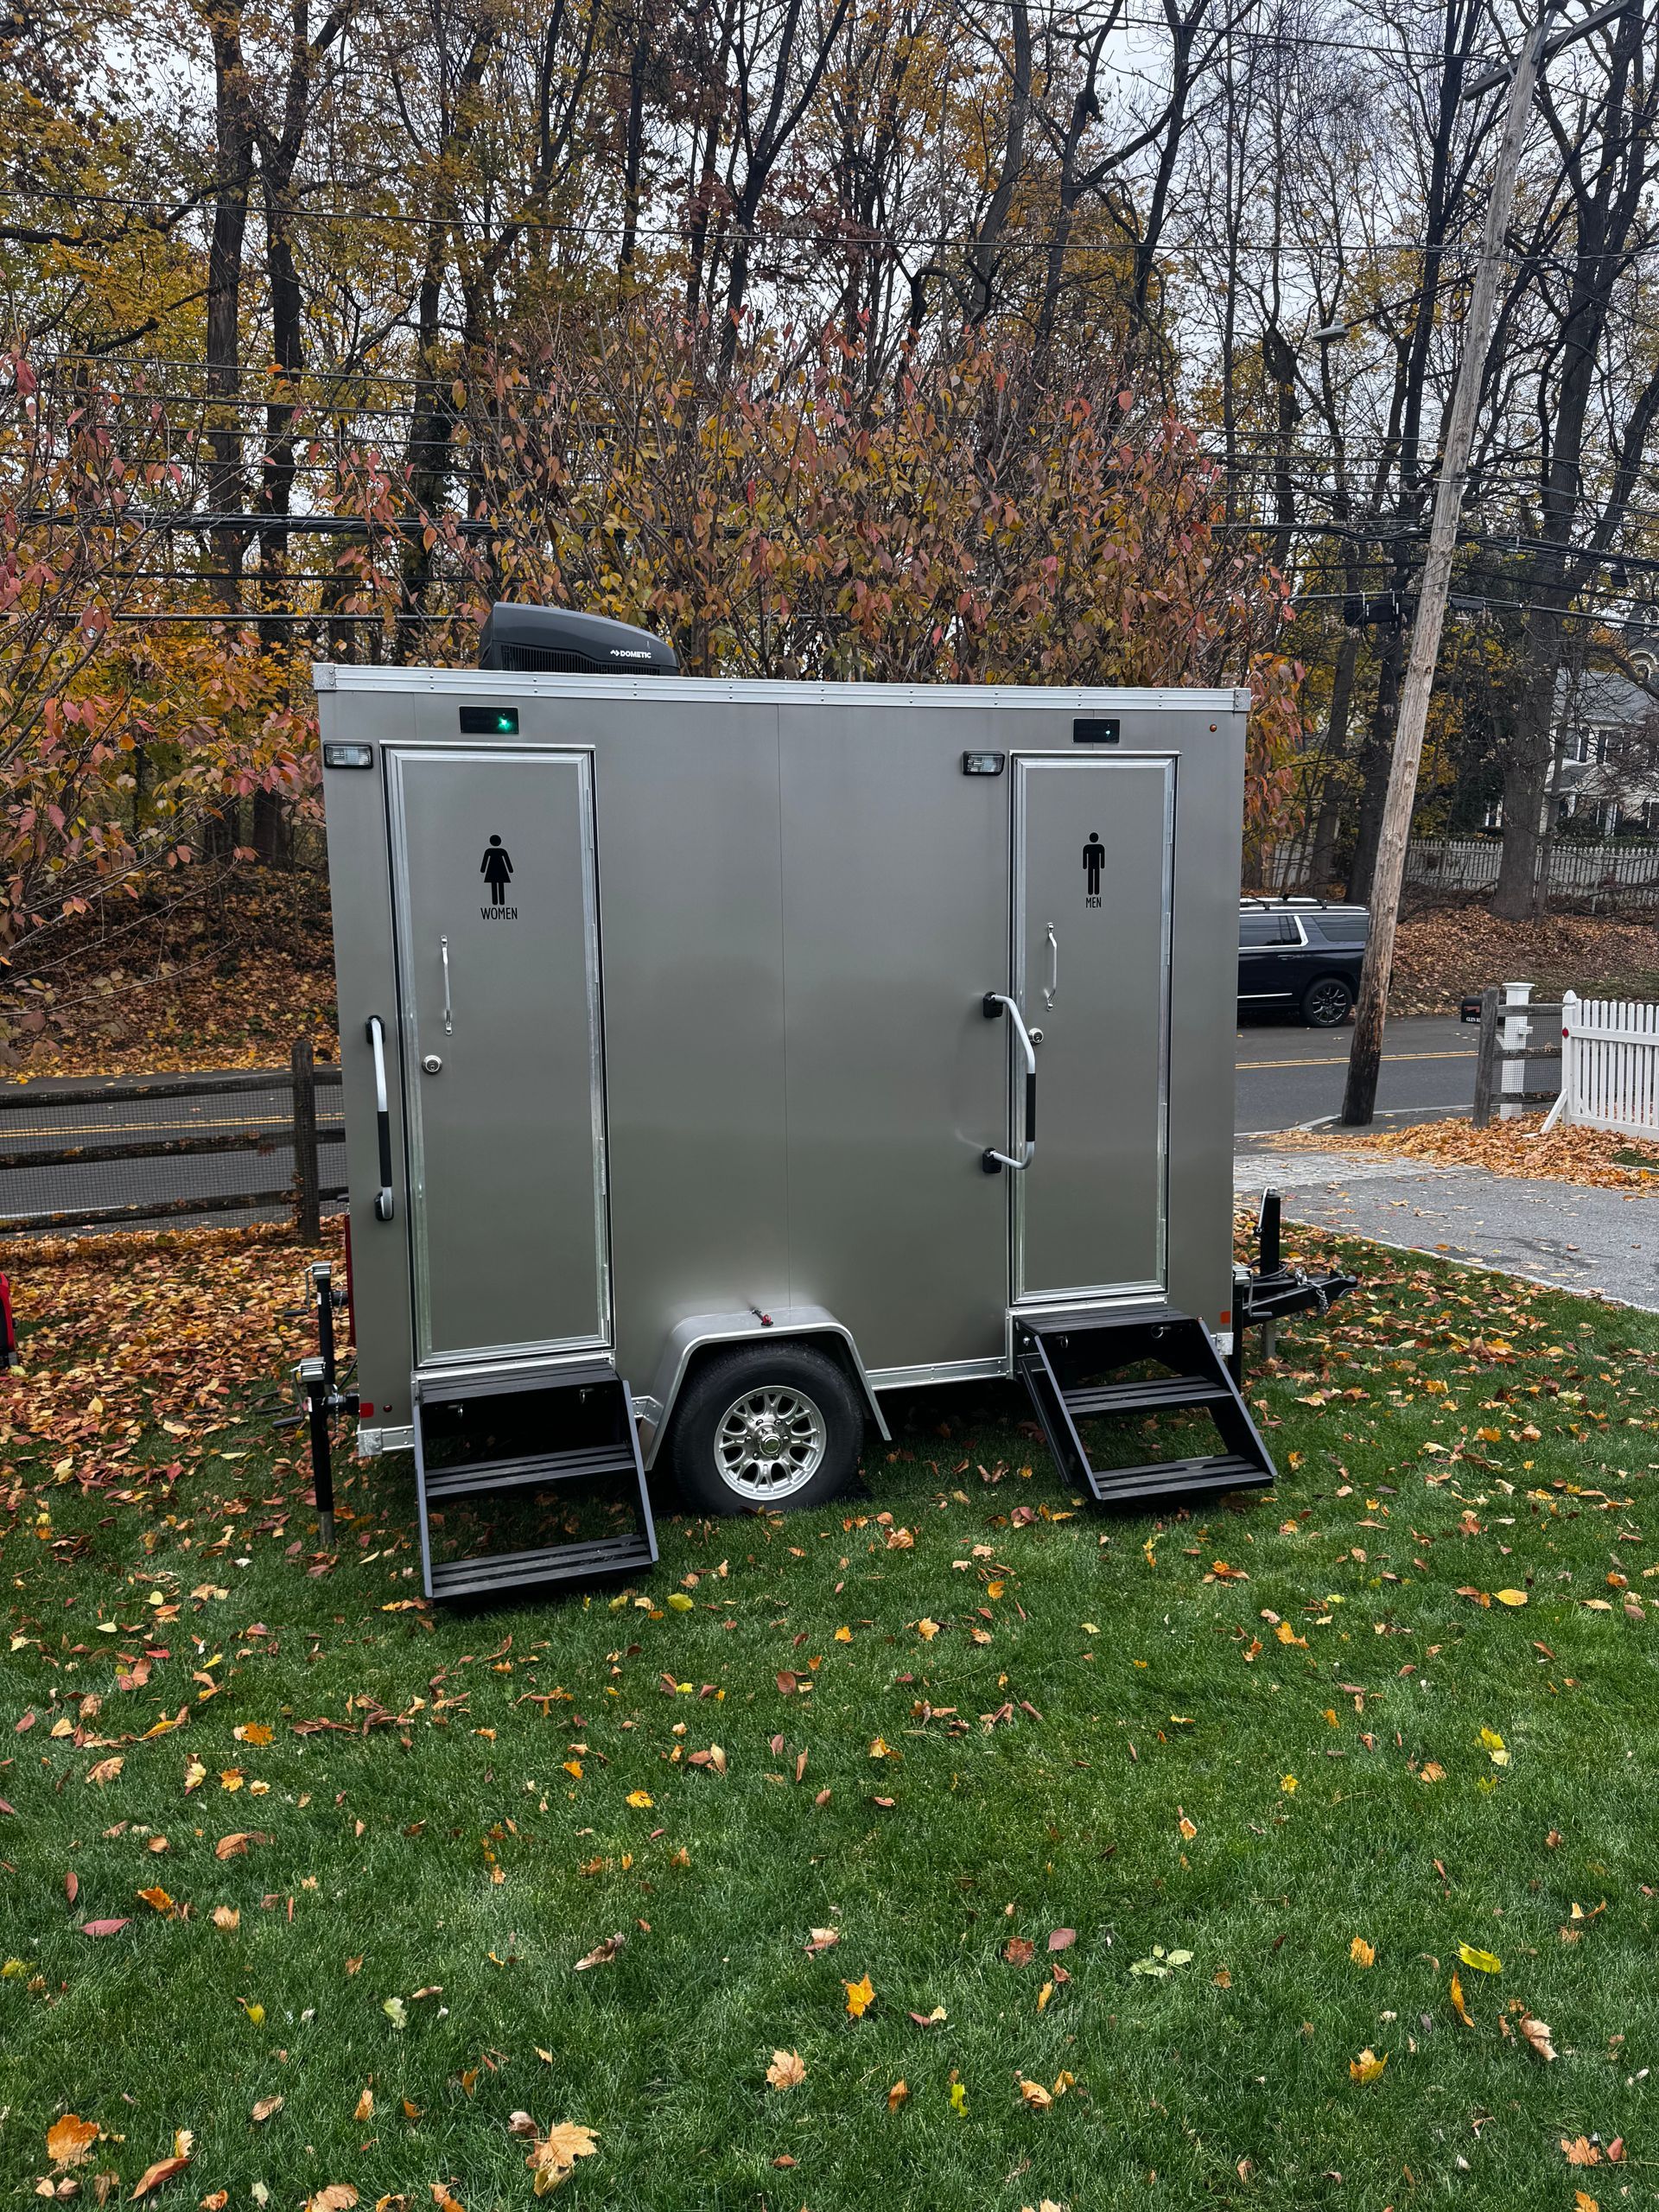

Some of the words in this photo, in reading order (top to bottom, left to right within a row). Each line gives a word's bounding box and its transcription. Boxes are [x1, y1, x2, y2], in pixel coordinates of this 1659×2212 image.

[620, 650, 652, 658] DOMETIC
[1085, 897, 1102, 908] MEN
[480, 907, 518, 919] WOMEN
